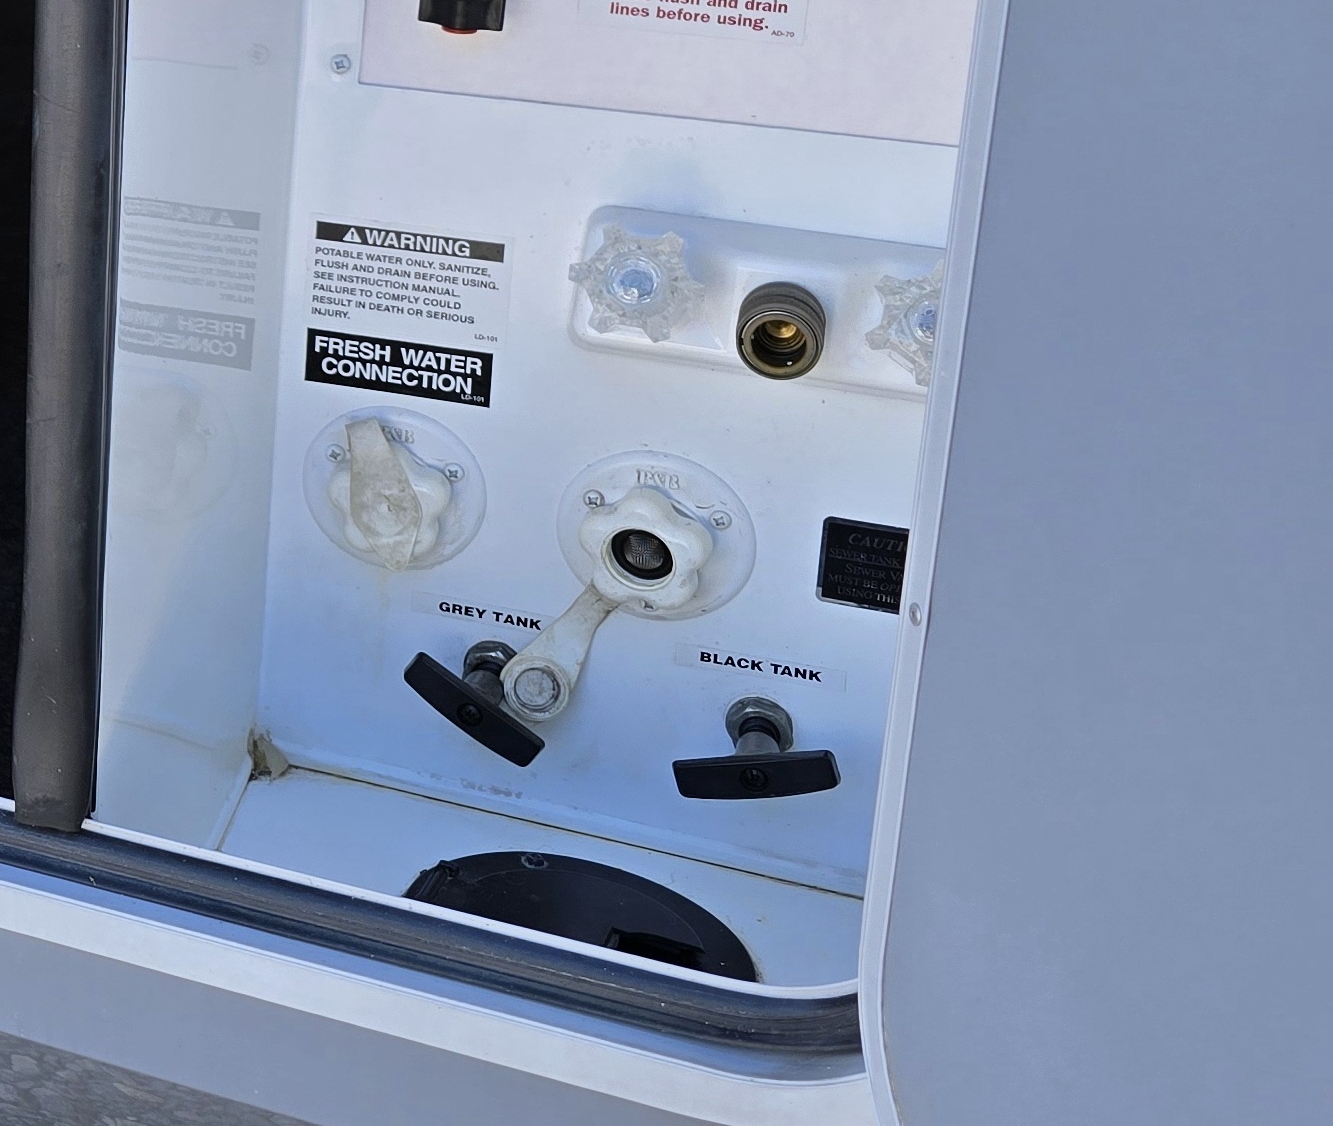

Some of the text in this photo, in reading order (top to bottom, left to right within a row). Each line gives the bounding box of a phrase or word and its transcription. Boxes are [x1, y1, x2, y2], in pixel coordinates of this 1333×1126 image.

[609, 2, 769, 32] lines before using.
[315, 246, 363, 260] POTABLE
[365, 252, 403, 265] WATER
[365, 228, 471, 257] WARNING
[313, 270, 461, 298] SEE INSTRUCTION MANUAL.
[315, 258, 499, 290] FLUSH AND DRAIN BEFORE USING.
[312, 294, 475, 324] RESULT IN DEATH OR SERIOUS
[313, 282, 461, 310] FAILURE TO COMPLY COULD
[311, 306, 351, 320] INJURY.
[475, 333, 498, 343] LD-101
[314, 335, 483, 376] FRESH WATER
[321, 356, 473, 395] CONNECTION
[461, 393, 485, 404] LD-101
[845, 563, 885, 579] SEWER
[869, 554, 901, 567] TANK
[828, 574, 861, 586] MUST
[863, 580, 878, 589] BE
[837, 586, 873, 599] USING
[438, 600, 542, 631] GREY TANK
[699, 650, 823, 683] BLACK TANK
